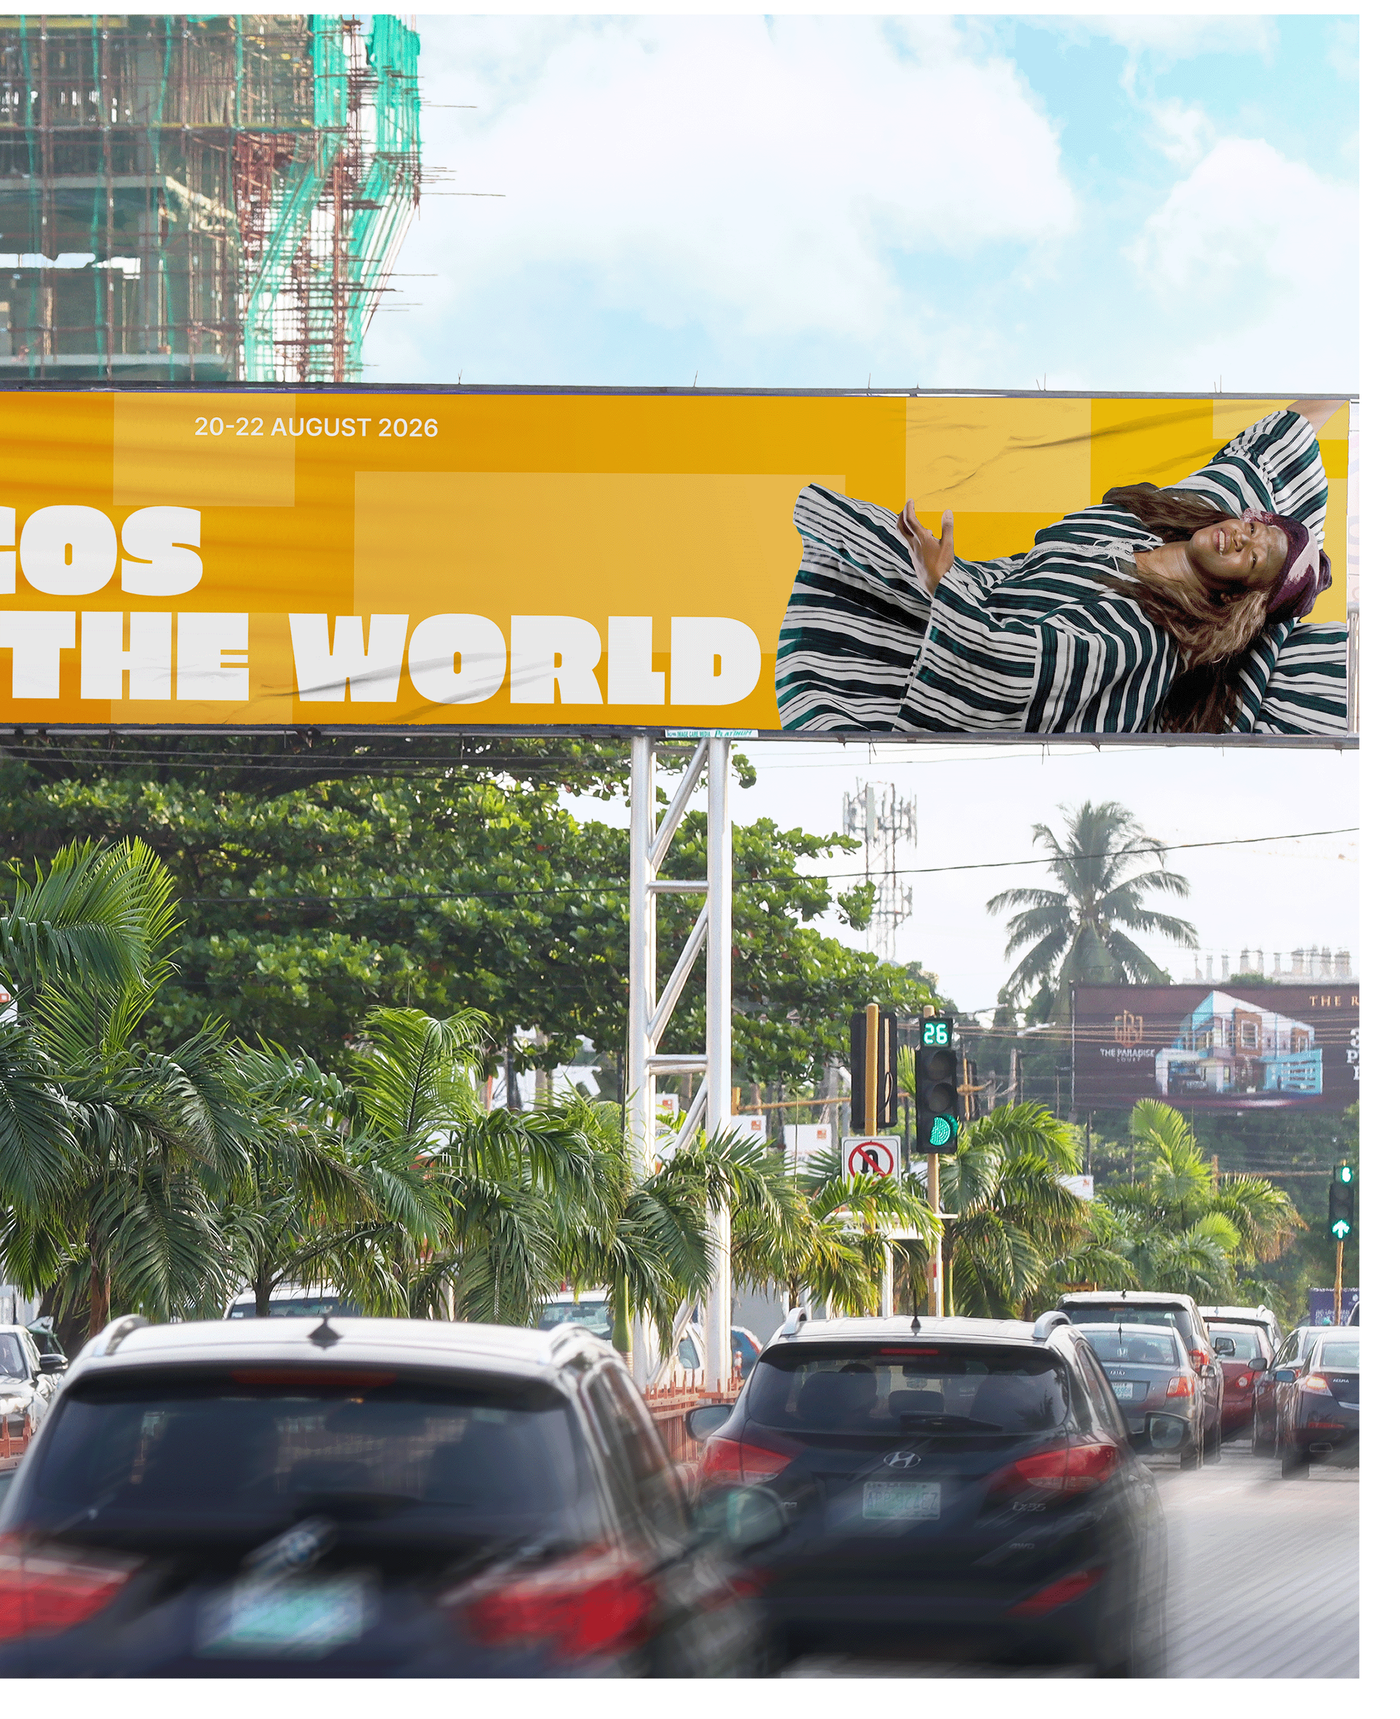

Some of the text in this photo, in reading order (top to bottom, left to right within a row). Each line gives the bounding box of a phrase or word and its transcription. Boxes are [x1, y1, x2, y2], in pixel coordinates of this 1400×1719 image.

[194, 416, 439, 438] 20-22 AUGUST 2026
[288, 613, 762, 706] WORLD
[1309, 995, 1342, 1007] THE
[923, 1022, 949, 1045] 26
